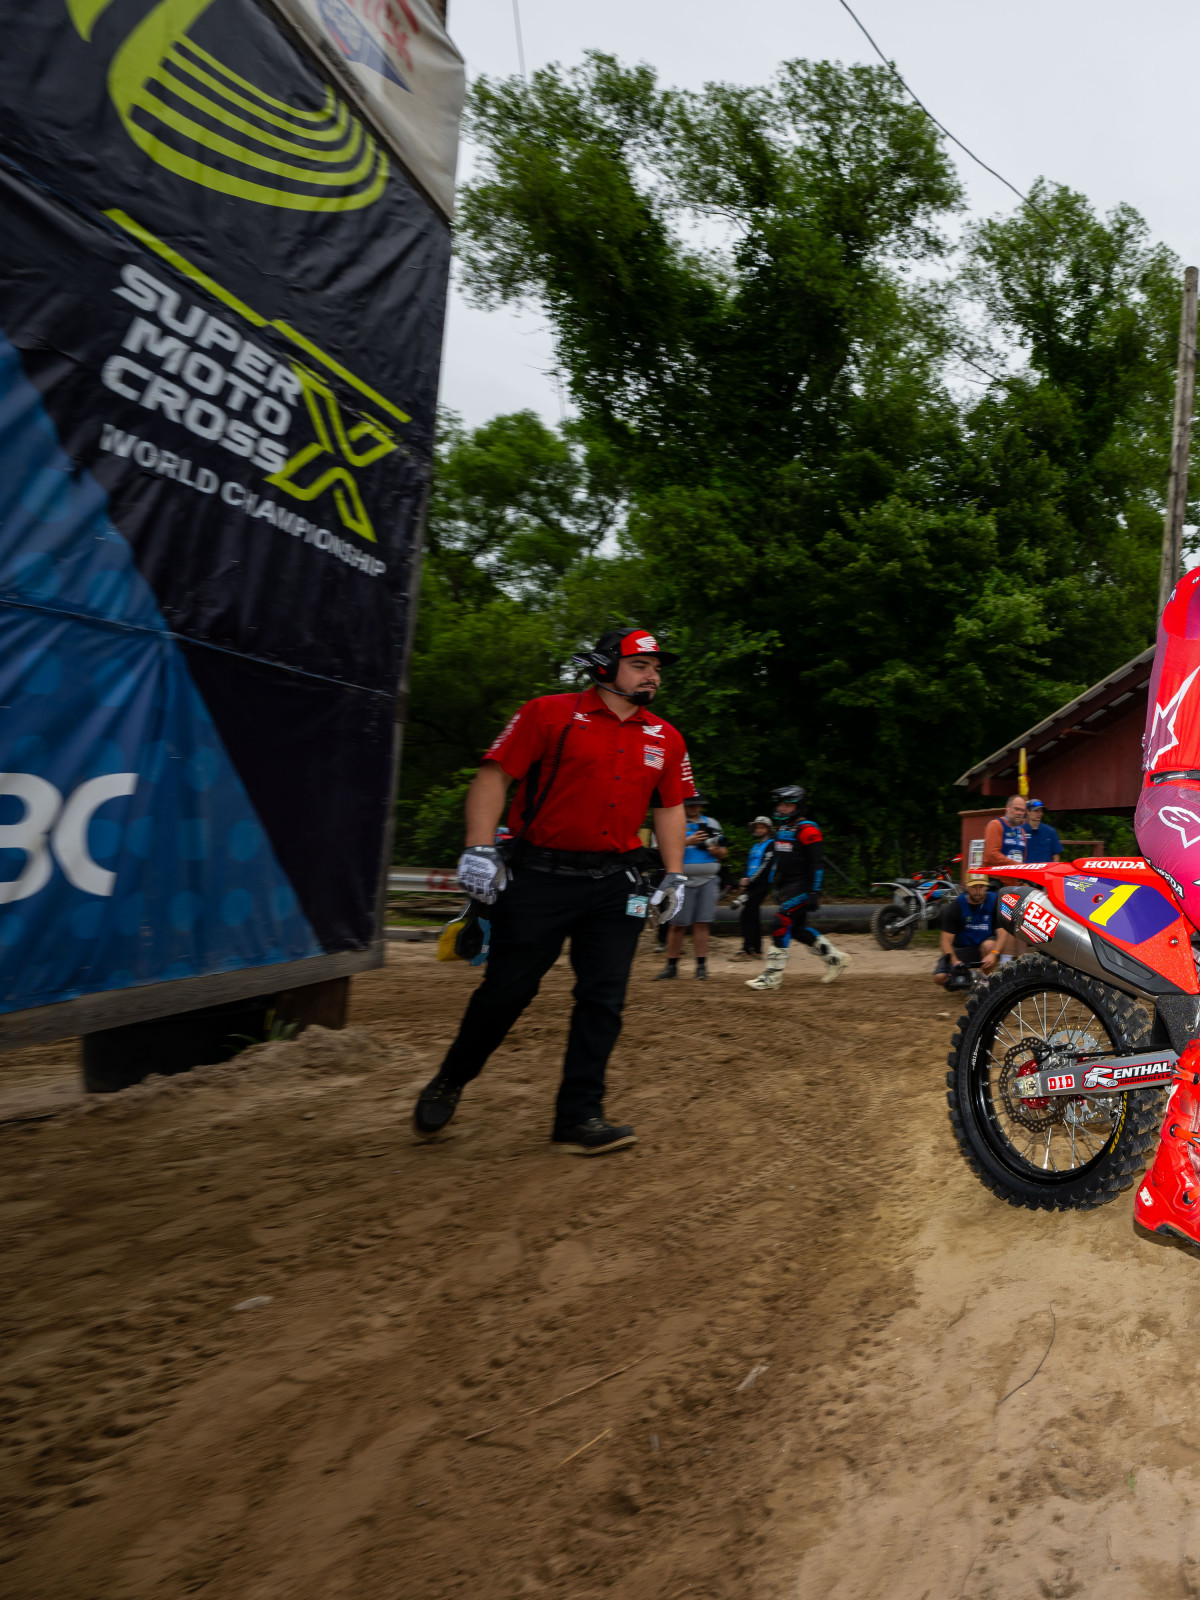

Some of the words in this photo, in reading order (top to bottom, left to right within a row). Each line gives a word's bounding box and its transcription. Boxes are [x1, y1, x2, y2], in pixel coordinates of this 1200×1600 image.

[111, 263, 304, 407] SUPER
[120, 316, 292, 436] MOTO
[101, 355, 290, 474] CROSS
[100, 423, 220, 494] WORLD
[220, 481, 387, 577] CHAMPIONSHIP
[1024, 903, 1060, 934] ヨシムラ
[1083, 860, 1147, 870] HONDA
[1089, 884, 1141, 927] 1
